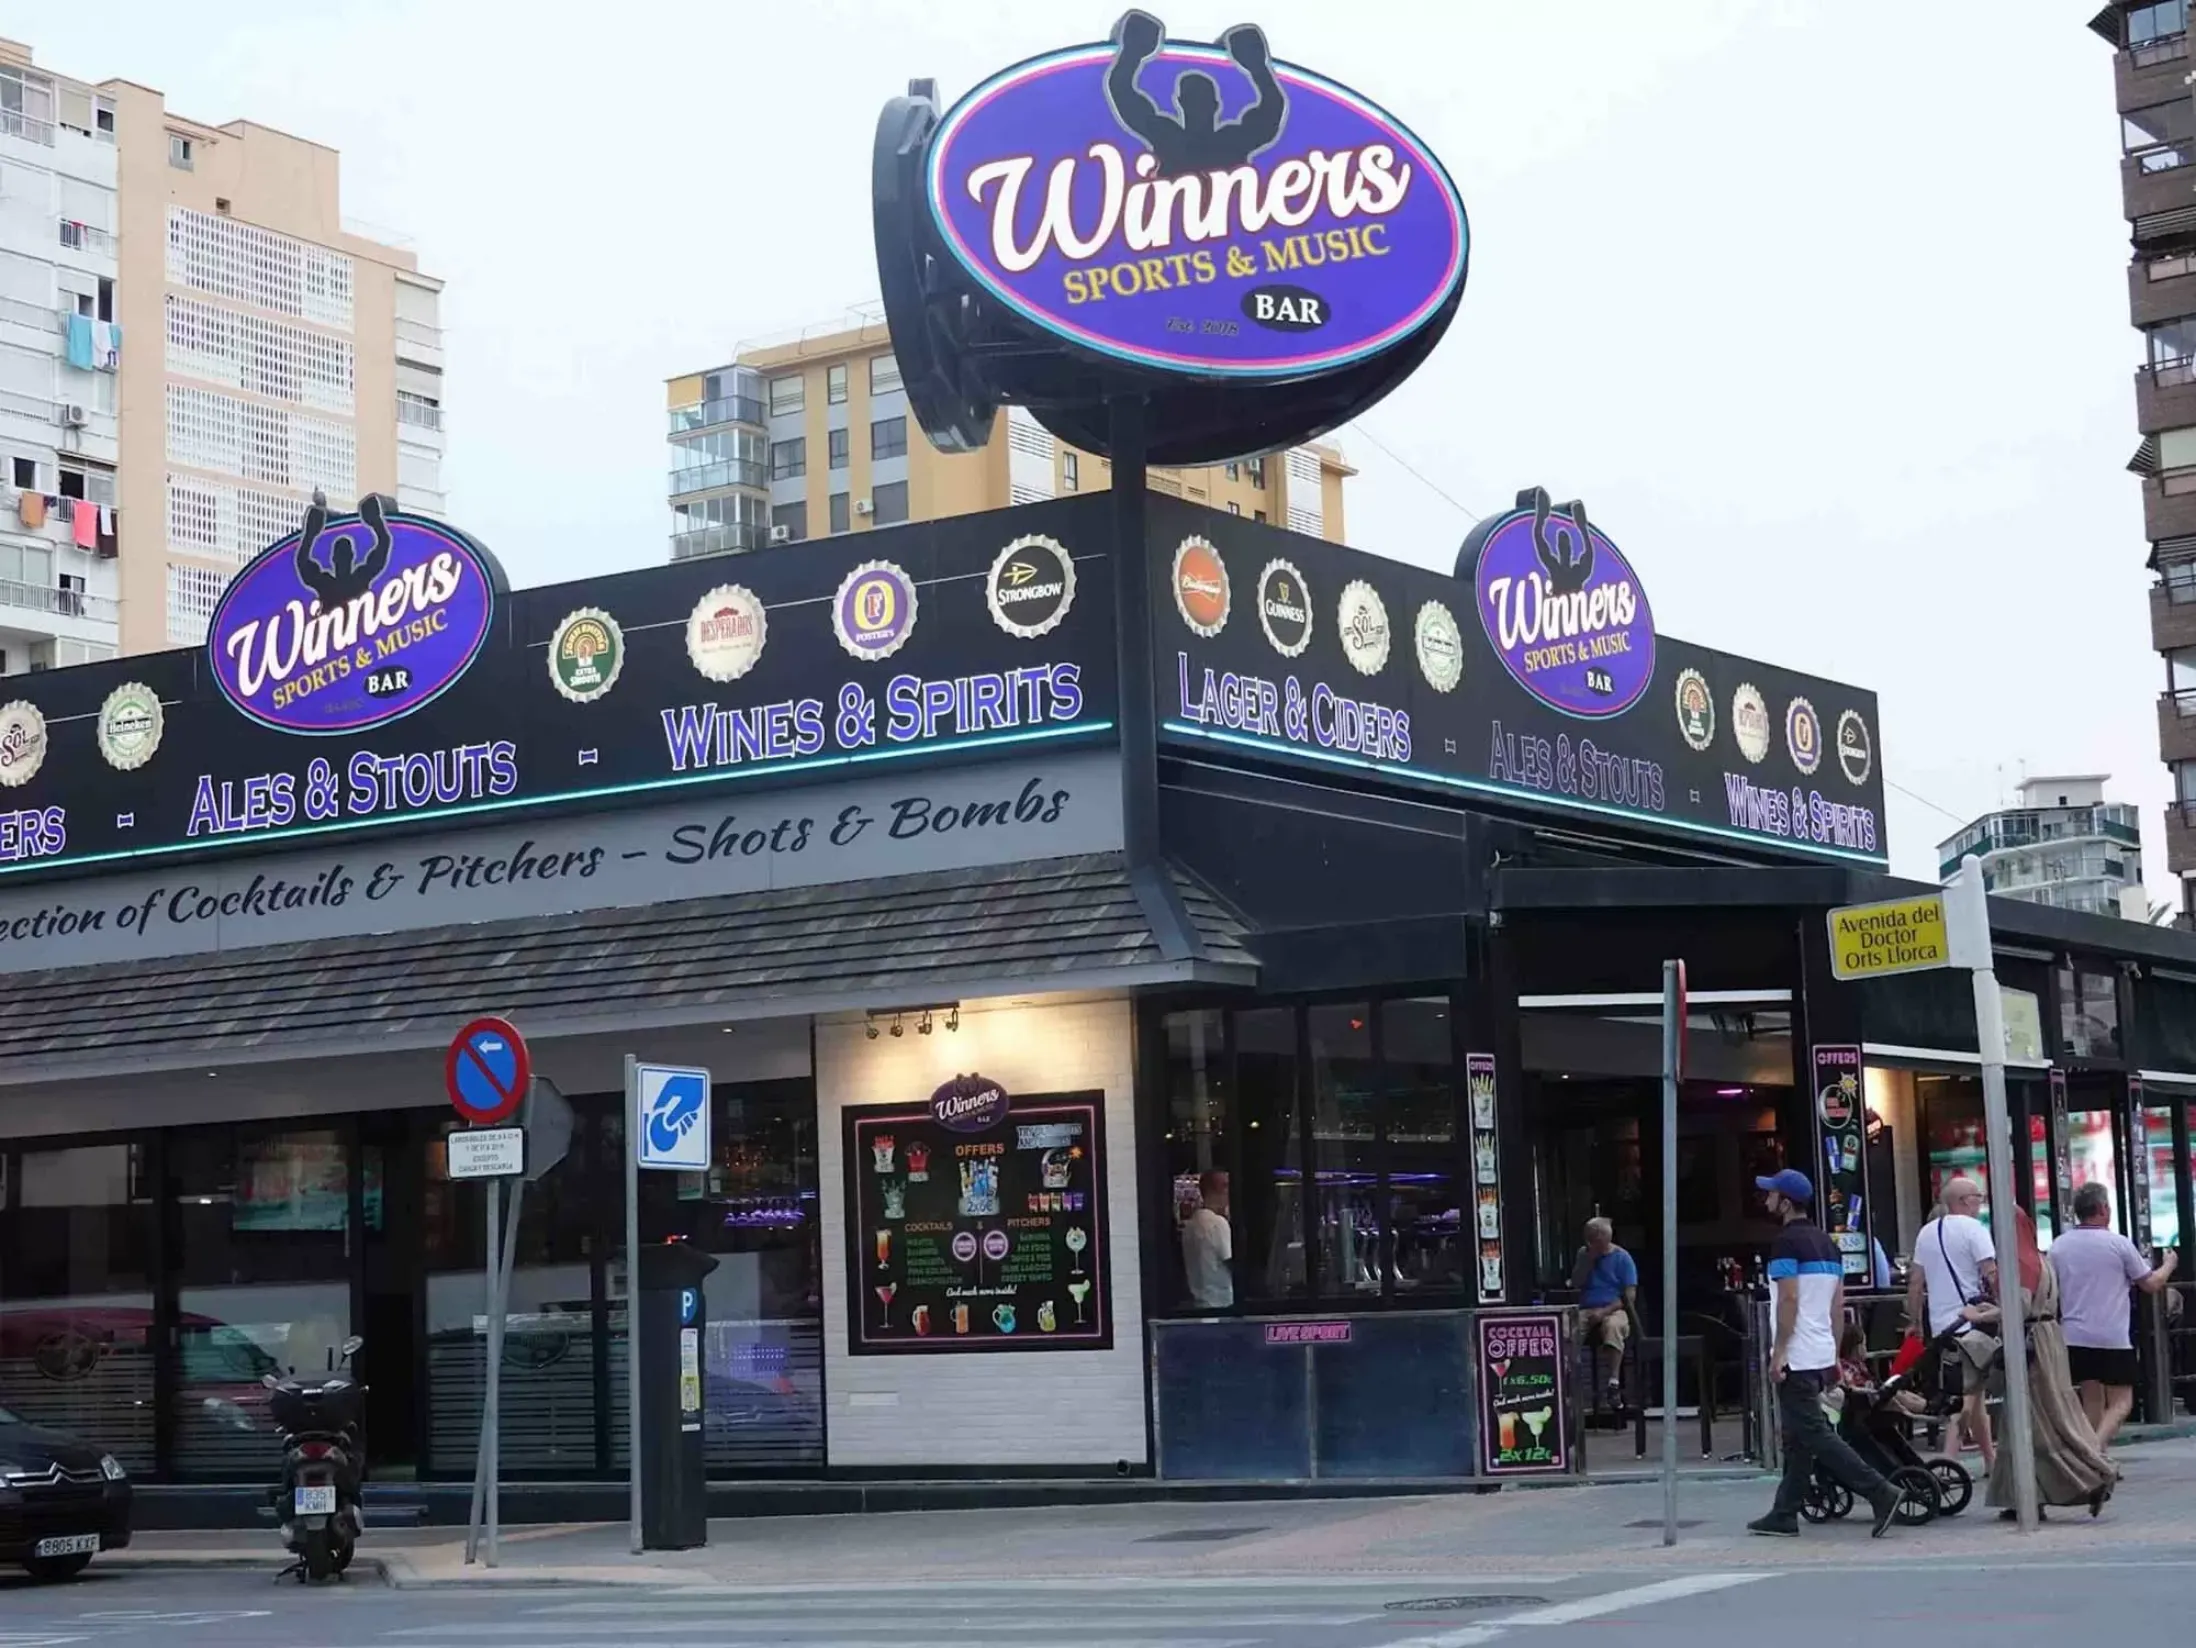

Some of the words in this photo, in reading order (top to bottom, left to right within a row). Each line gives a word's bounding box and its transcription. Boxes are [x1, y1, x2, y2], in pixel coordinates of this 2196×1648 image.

[968, 144, 1411, 272] Winners
[1064, 251, 1216, 304] SPORTS
[1226, 248, 1257, 277] &
[1261, 224, 1390, 272] MUSIC
[1255, 294, 1322, 324] BAR
[999, 582, 1062, 606] STRONGBOW
[227, 551, 462, 697] Winners
[1265, 599, 1305, 623] GUINNESS
[1489, 572, 1636, 651] Winners
[1352, 615, 1375, 650] SOL
[272, 659, 350, 710] SPORTS
[355, 649, 373, 668] &
[376, 609, 448, 656] MUSIC
[1524, 638, 1578, 674] SPORTS
[1578, 640, 1590, 661] &
[1591, 631, 1632, 660] MUSIC
[368, 670, 410, 695] BAR
[1586, 669, 1613, 693] BAR
[187, 773, 296, 838] ALES
[303, 756, 339, 829] &
[347, 740, 518, 816] STOUTS
[661, 698, 826, 771] WINES
[834, 681, 875, 749] &
[886, 662, 1083, 742] SPIRITS
[1178, 650, 1281, 737] LAGER
[1284, 675, 1308, 743] &
[1311, 681, 1412, 762] CIDERS
[1488, 720, 1552, 792] ALES
[1557, 735, 1577, 794] &
[1579, 738, 1665, 813] STOUTS
[1724, 771, 1791, 837] WINES
[1791, 786, 1809, 840] &
[1809, 790, 1877, 853] SPIRITS
[116, 888, 165, 937] of
[167, 860, 354, 925] Cocktails
[366, 861, 404, 901] &
[418, 839, 606, 897] Pitchers
[665, 811, 815, 866] Shots
[830, 804, 875, 847] &
[888, 776, 1071, 841] Bombs
[1838, 911, 1907, 935] Avenida
[1912, 903, 1940, 926] del
[1845, 948, 1884, 970] Orts
[1887, 940, 1939, 963] Llorca
[1860, 928, 1918, 951] Doctor
[935, 1087, 1000, 1121] Winners
[955, 1143, 1005, 1157] OFFERS
[904, 1221, 953, 1233] COCKTAILS
[1007, 1217, 1051, 1228] PITCHERS
[683, 1291, 693, 1318] P
[1488, 1326, 1553, 1340] COCKTAIL
[1488, 1337, 1555, 1359] OFFER
